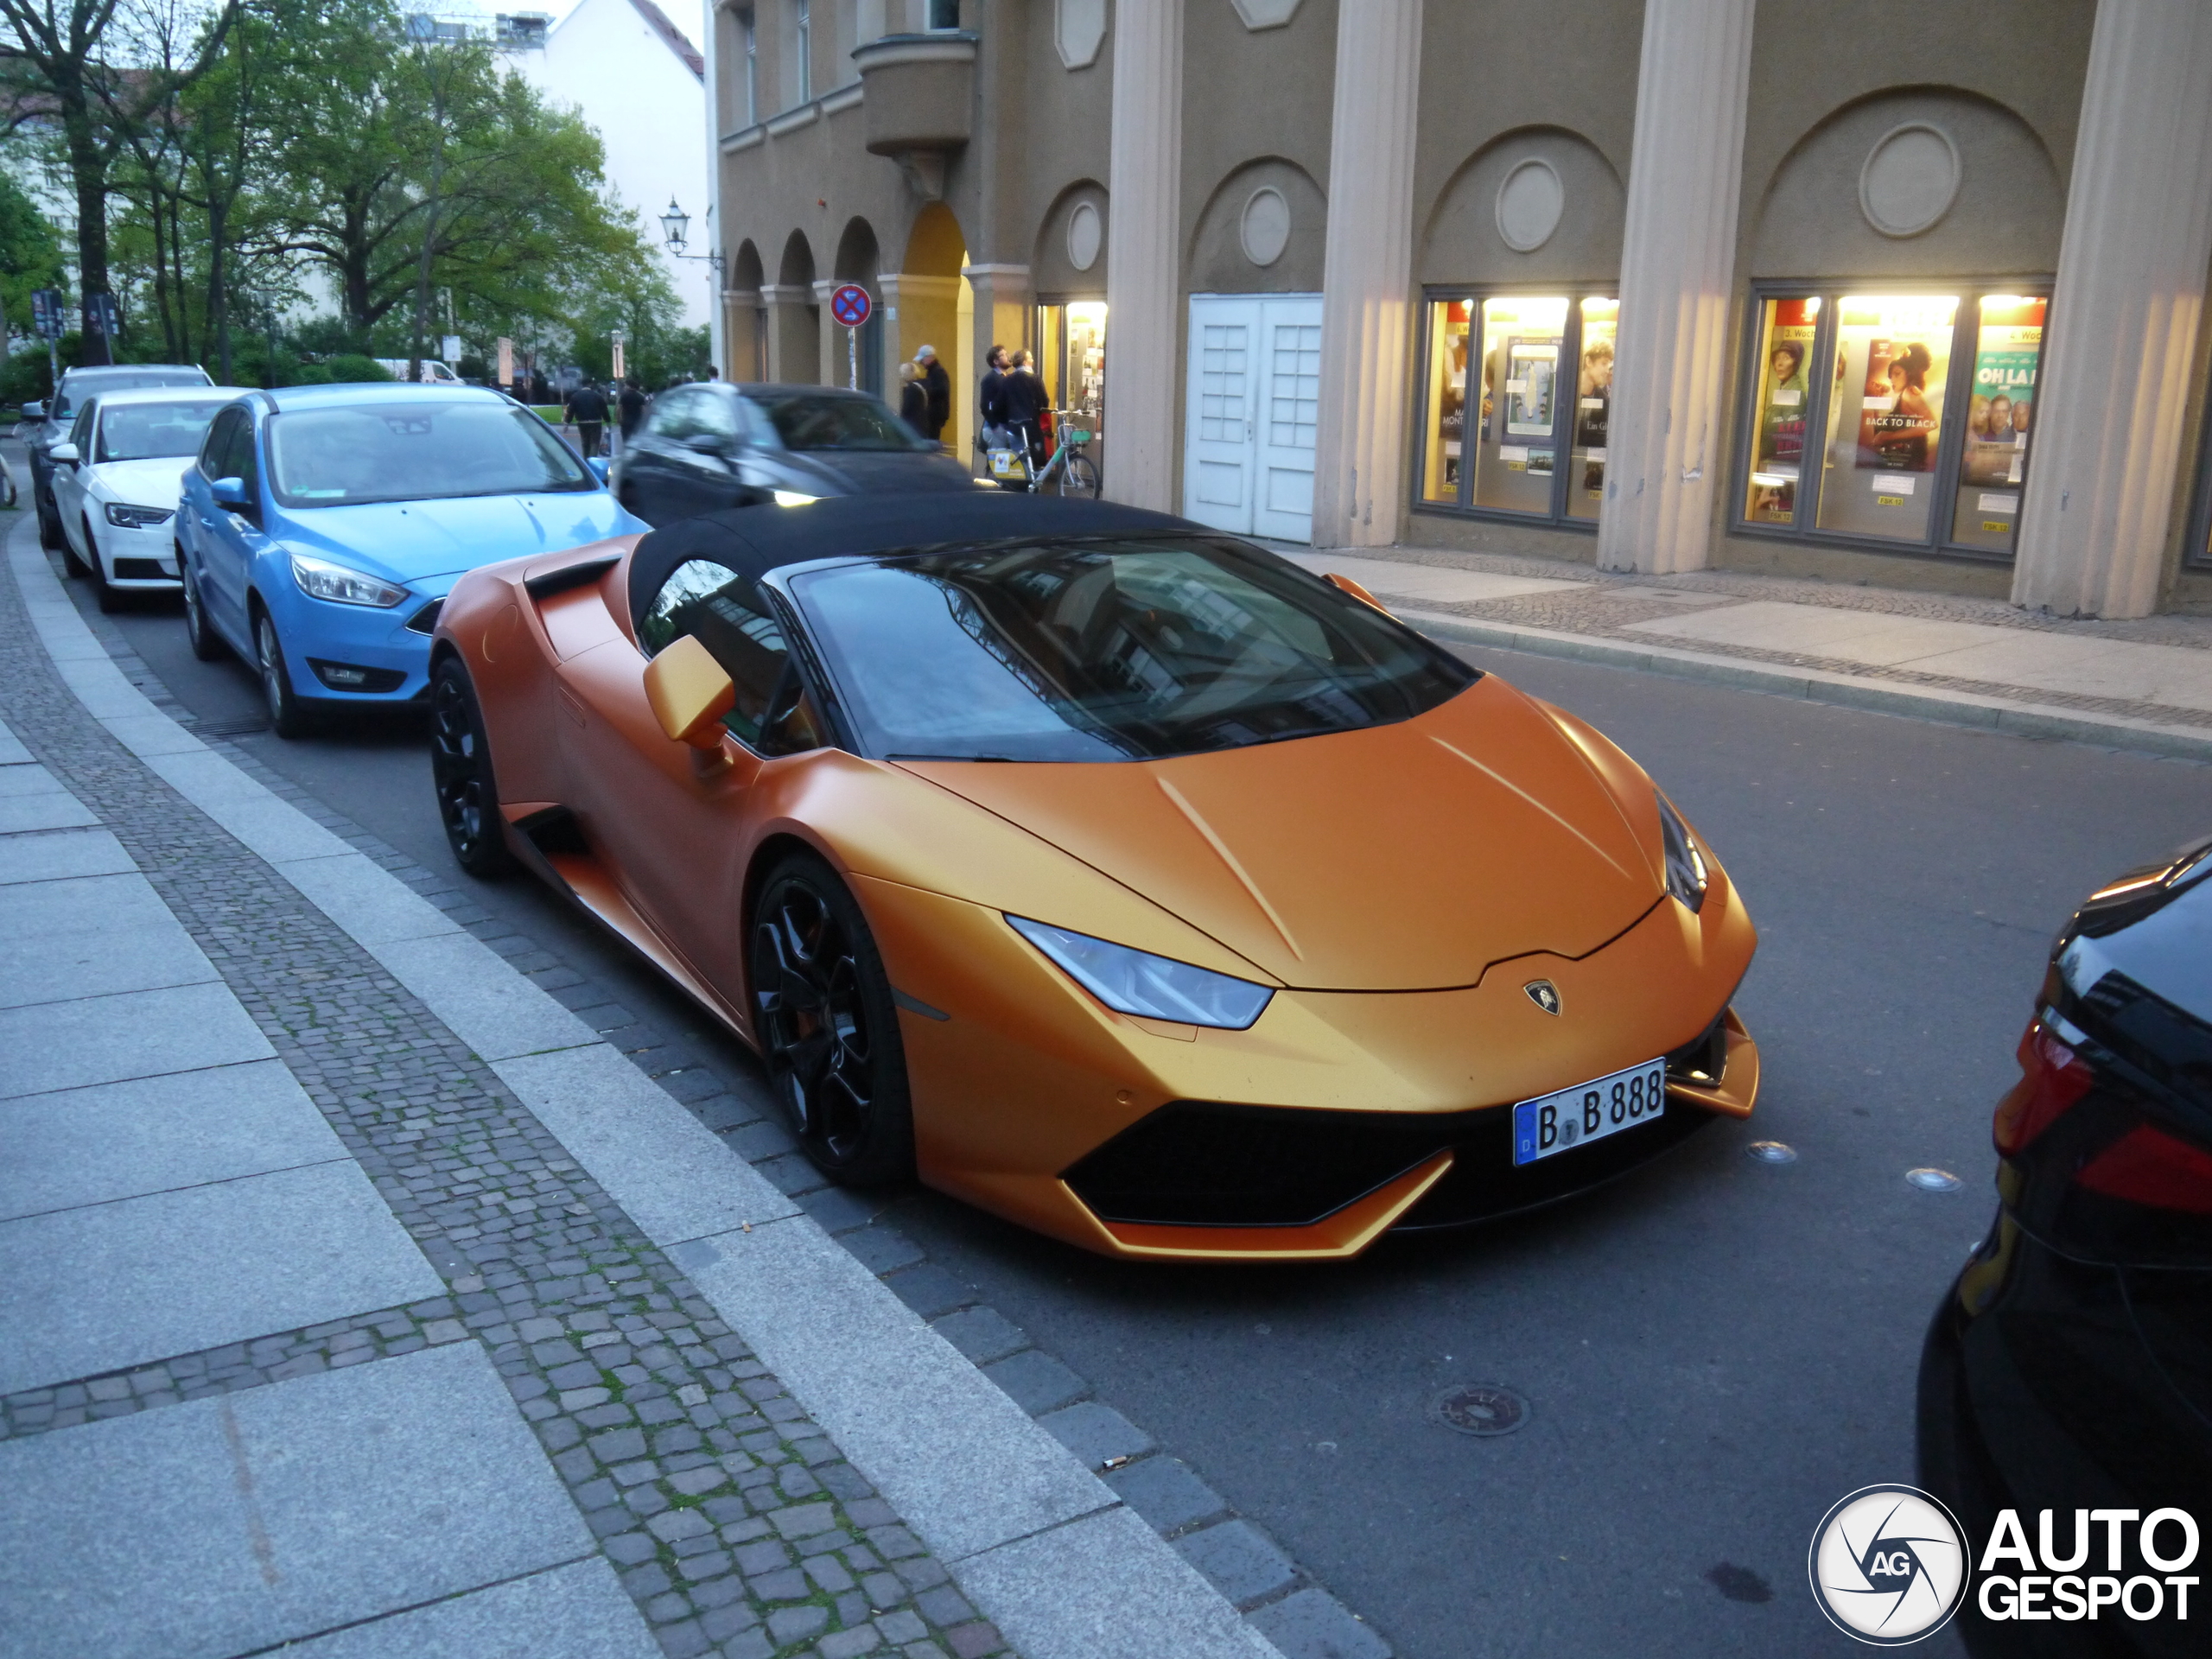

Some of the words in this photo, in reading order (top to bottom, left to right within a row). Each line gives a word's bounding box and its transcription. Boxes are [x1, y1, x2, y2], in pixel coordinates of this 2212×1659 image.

[1785, 329, 1792, 338] 3.
[1795, 329, 1815, 338] Woch
[1978, 367, 2005, 385] OH
[2006, 368, 2028, 385] LA
[1586, 421, 1598, 430] Ein
[1866, 417, 1888, 426] BACK
[1539, 1105, 1558, 1150] B
[1584, 1090, 1601, 1135] B
[1611, 1069, 1662, 1125] 888
[1522, 1139, 1530, 1152] D
